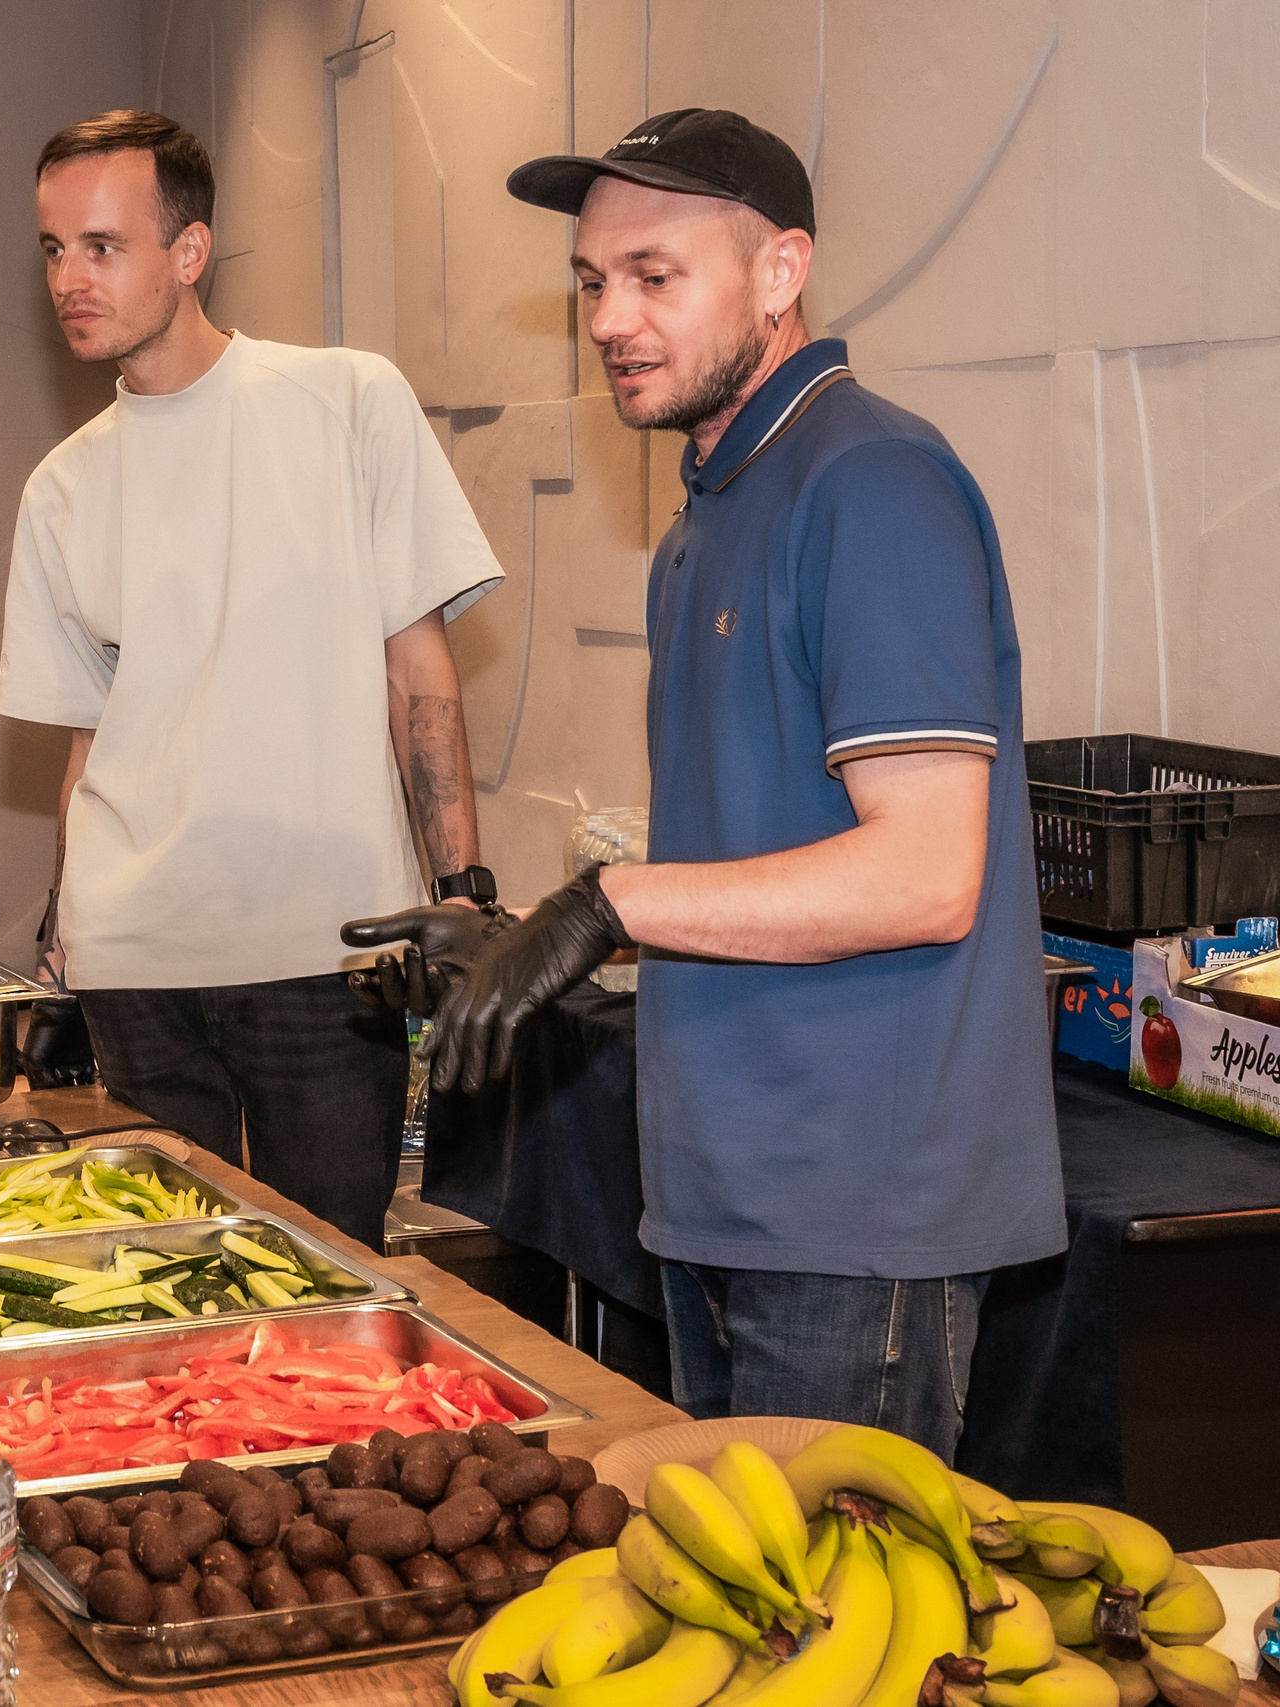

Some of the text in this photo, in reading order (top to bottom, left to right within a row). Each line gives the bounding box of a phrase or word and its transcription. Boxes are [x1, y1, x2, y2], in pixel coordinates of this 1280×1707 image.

[1205, 947, 1251, 960] Sunriver
[1210, 1027, 1280, 1084] Apples
[1202, 1071, 1220, 1086] Fresh
[1222, 1077, 1239, 1092] fruits
[1240, 1085, 1271, 1103] premium
